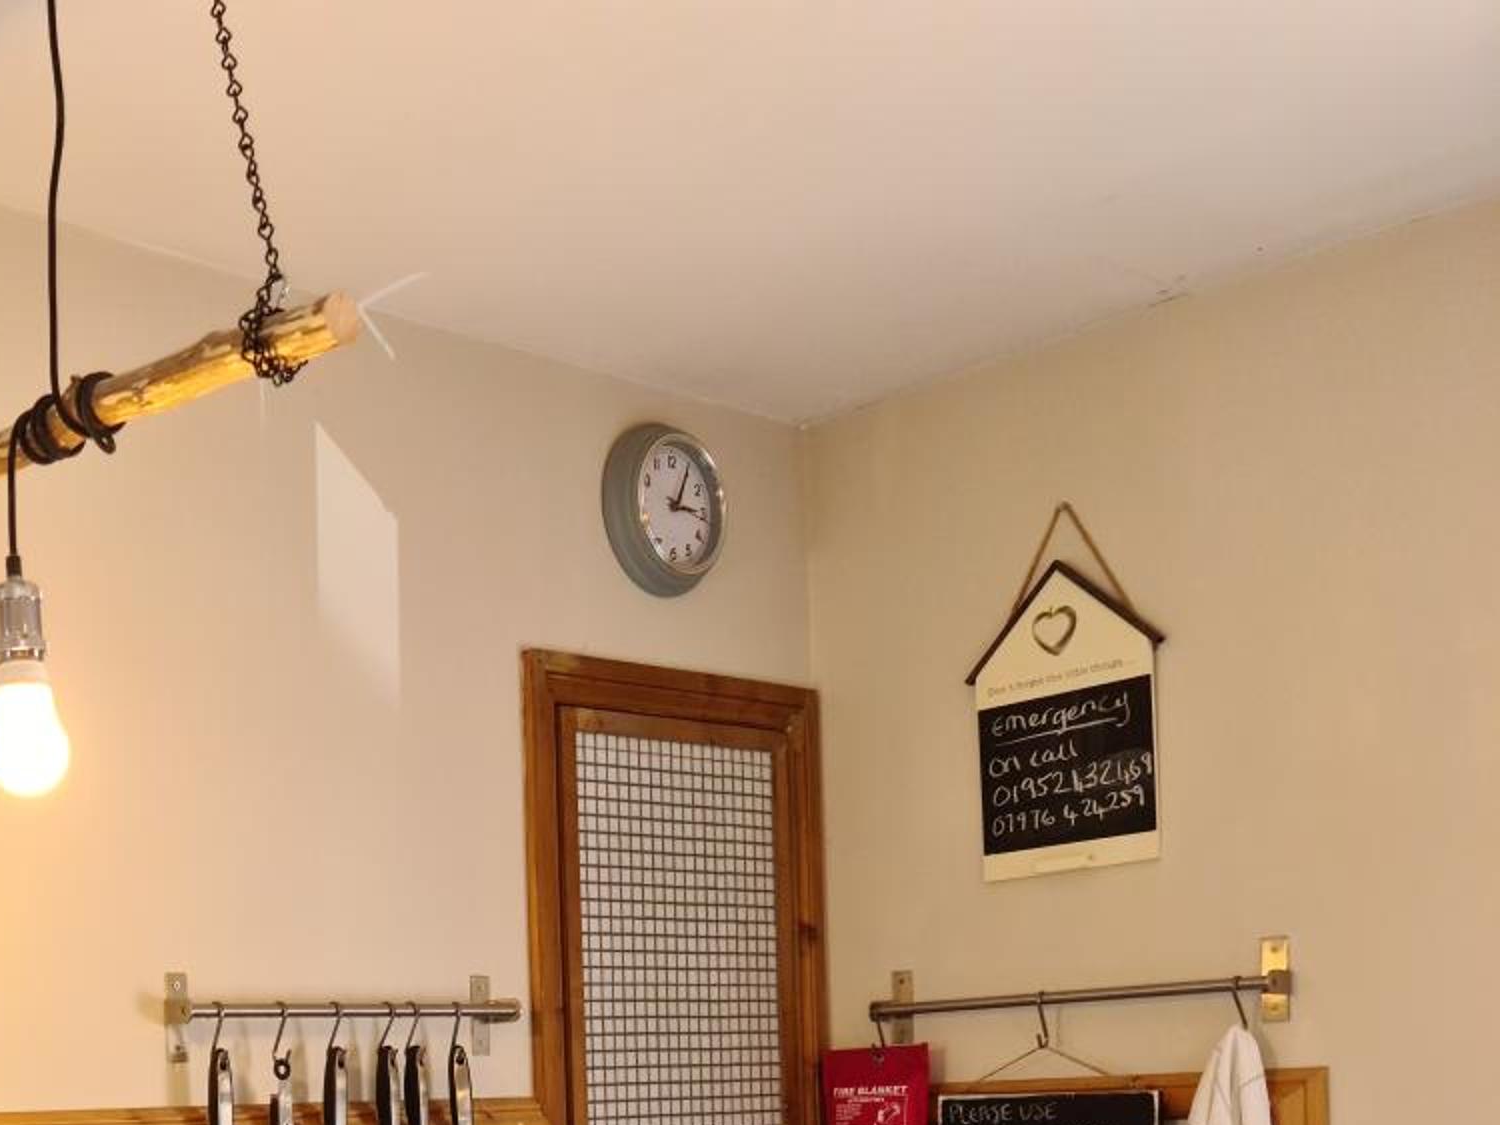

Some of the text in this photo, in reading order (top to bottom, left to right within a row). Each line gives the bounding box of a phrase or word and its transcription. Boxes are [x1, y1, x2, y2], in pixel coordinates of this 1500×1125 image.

[668, 455, 677, 469] 12
[1029, 739, 1078, 767] call
[857, 1085, 908, 1097] BLANKET
[950, 1102, 1058, 1125] PLEASE USE
